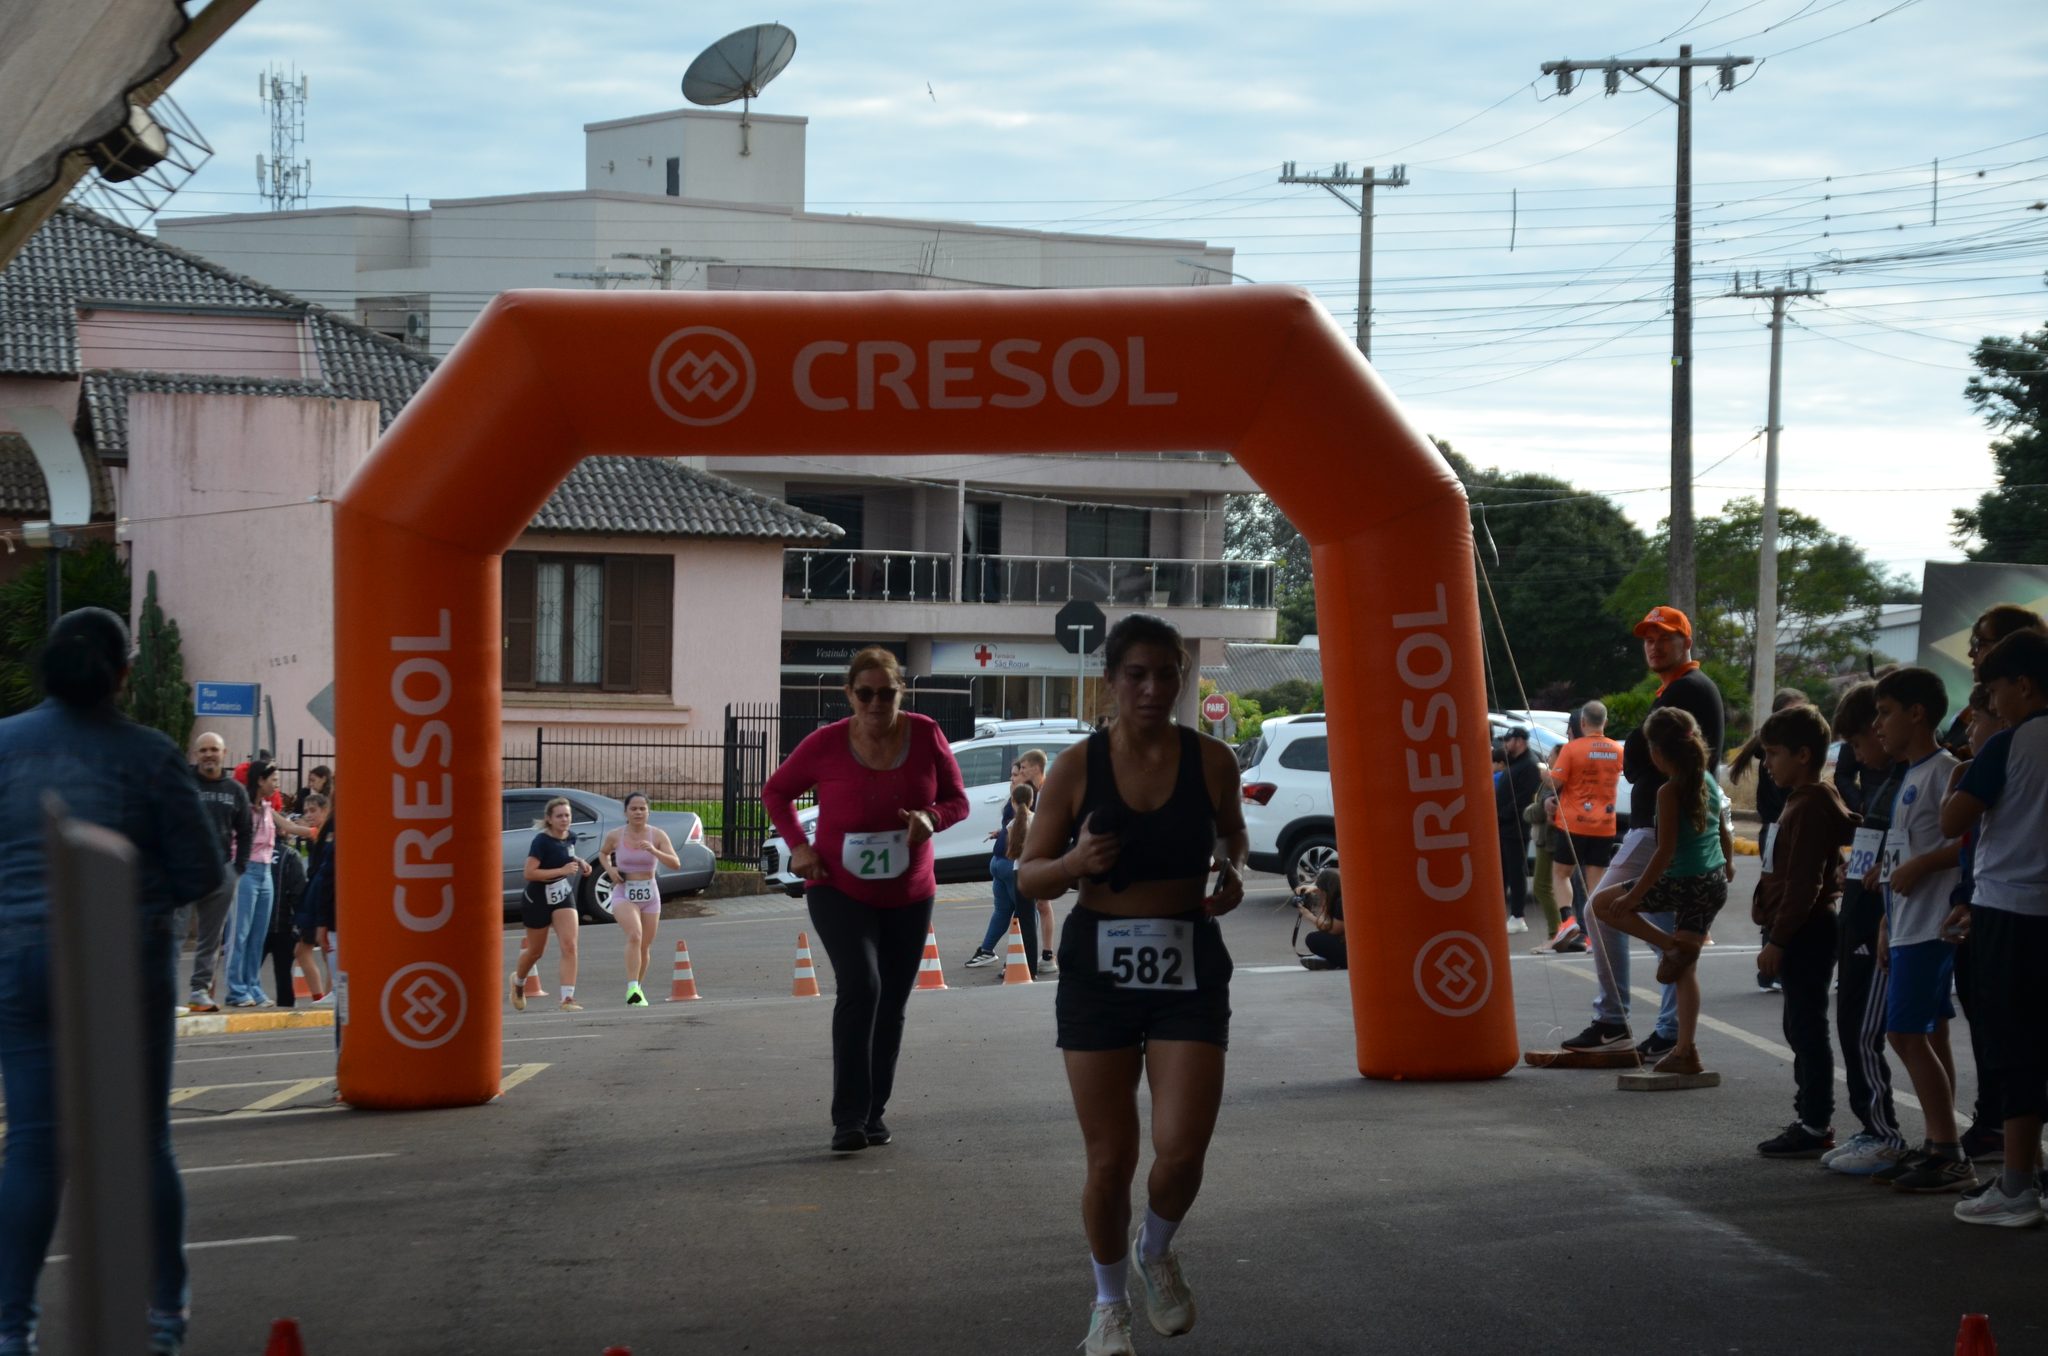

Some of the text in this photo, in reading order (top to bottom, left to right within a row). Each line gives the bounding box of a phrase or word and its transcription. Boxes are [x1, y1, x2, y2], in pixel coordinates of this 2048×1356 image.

[792, 336, 1178, 411] CRESOL
[994, 659, 1030, 669] São Roque
[202, 687, 217, 697] Rua
[1206, 703, 1225, 712] PARE
[1392, 582, 1473, 901] CRESOL
[390, 608, 454, 932] CRESOL
[860, 848, 890, 875] 21
[629, 888, 651, 901] 663
[1112, 946, 1184, 985] 582
